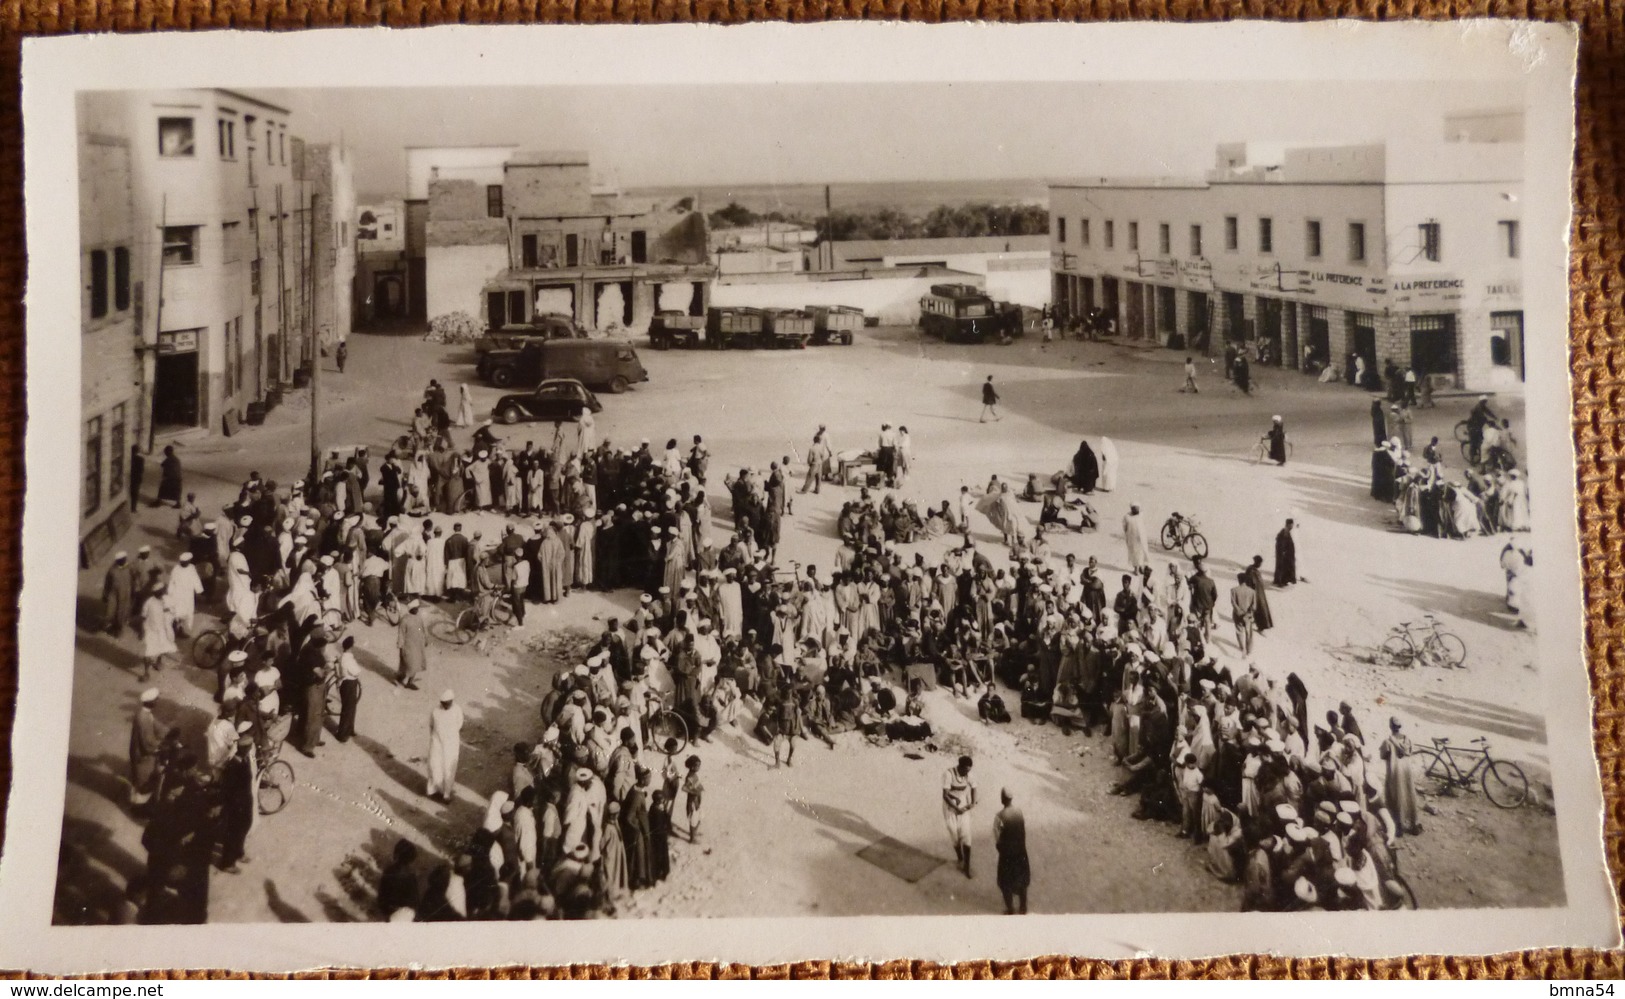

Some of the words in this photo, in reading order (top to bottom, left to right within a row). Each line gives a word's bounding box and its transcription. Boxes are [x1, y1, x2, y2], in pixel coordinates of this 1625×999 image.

[1394, 282, 1399, 290] A
[1401, 281, 1412, 290] LA
[1413, 279, 1465, 290] PREFERENCE
